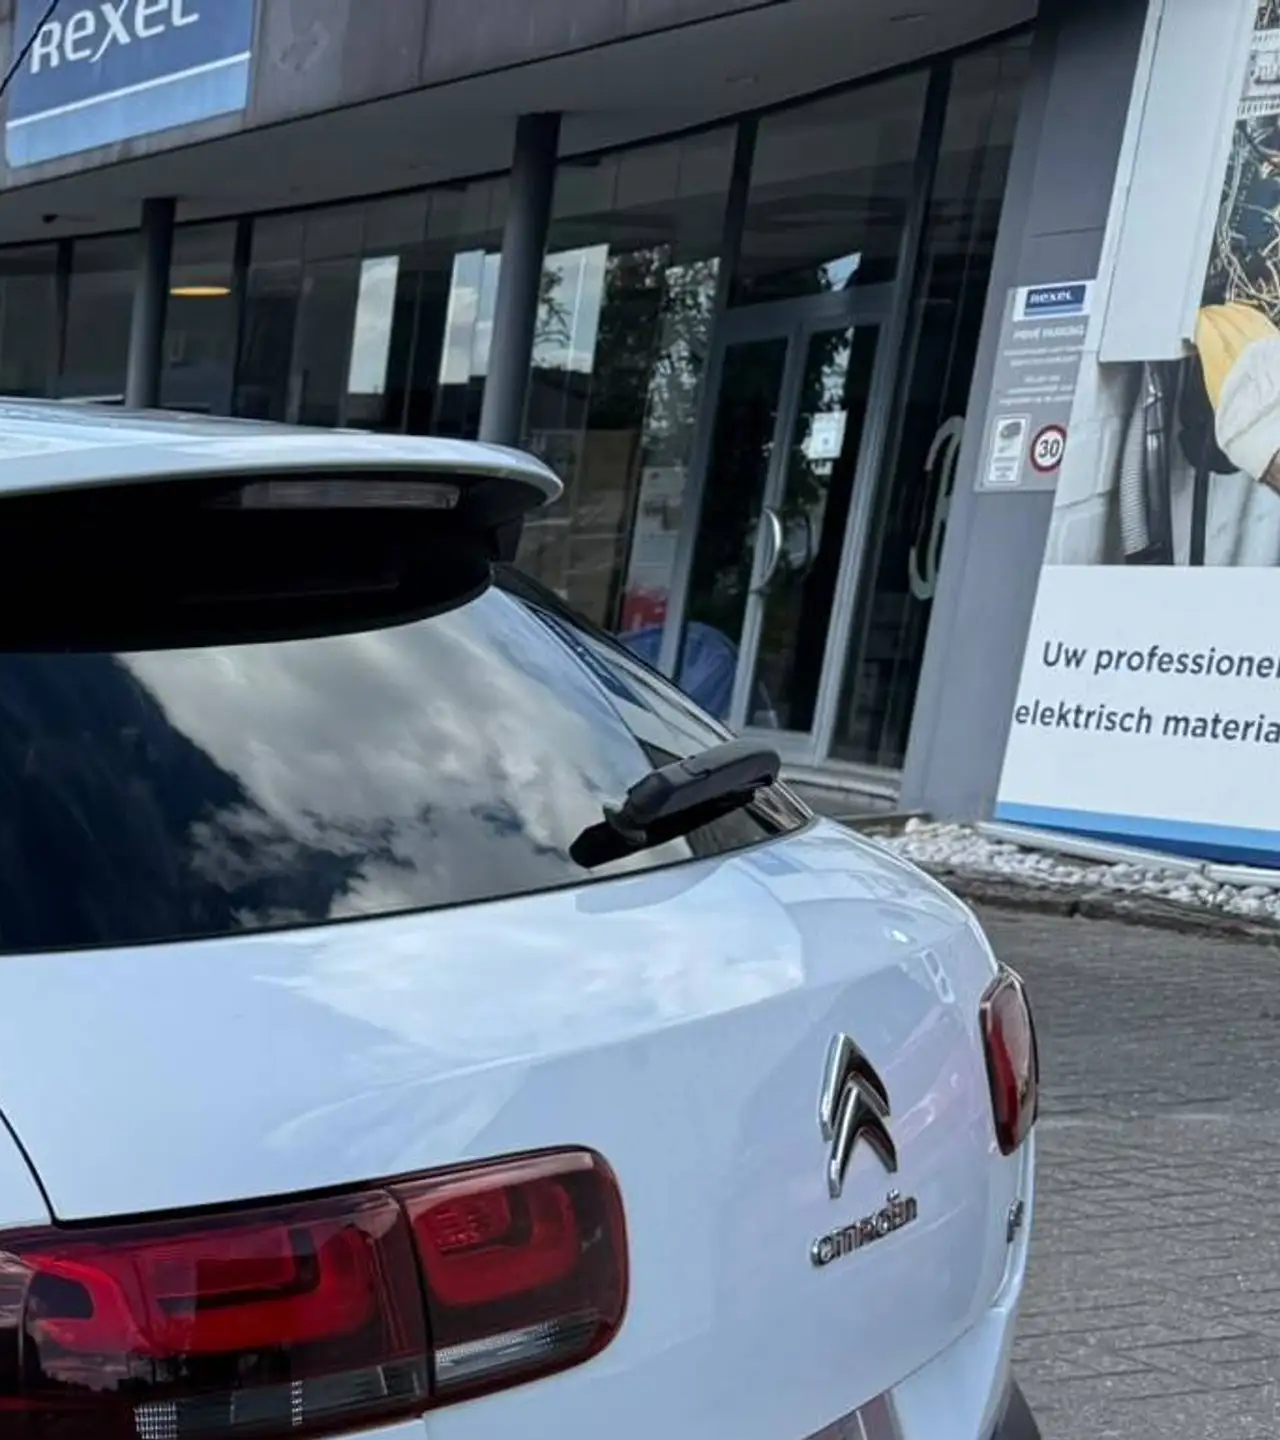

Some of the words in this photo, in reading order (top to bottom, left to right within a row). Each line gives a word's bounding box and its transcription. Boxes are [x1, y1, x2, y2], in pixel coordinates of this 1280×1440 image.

[1039, 439, 1060, 458] 30
[1042, 641, 1086, 669] Uw
[1015, 699, 1153, 733] elektrisch
